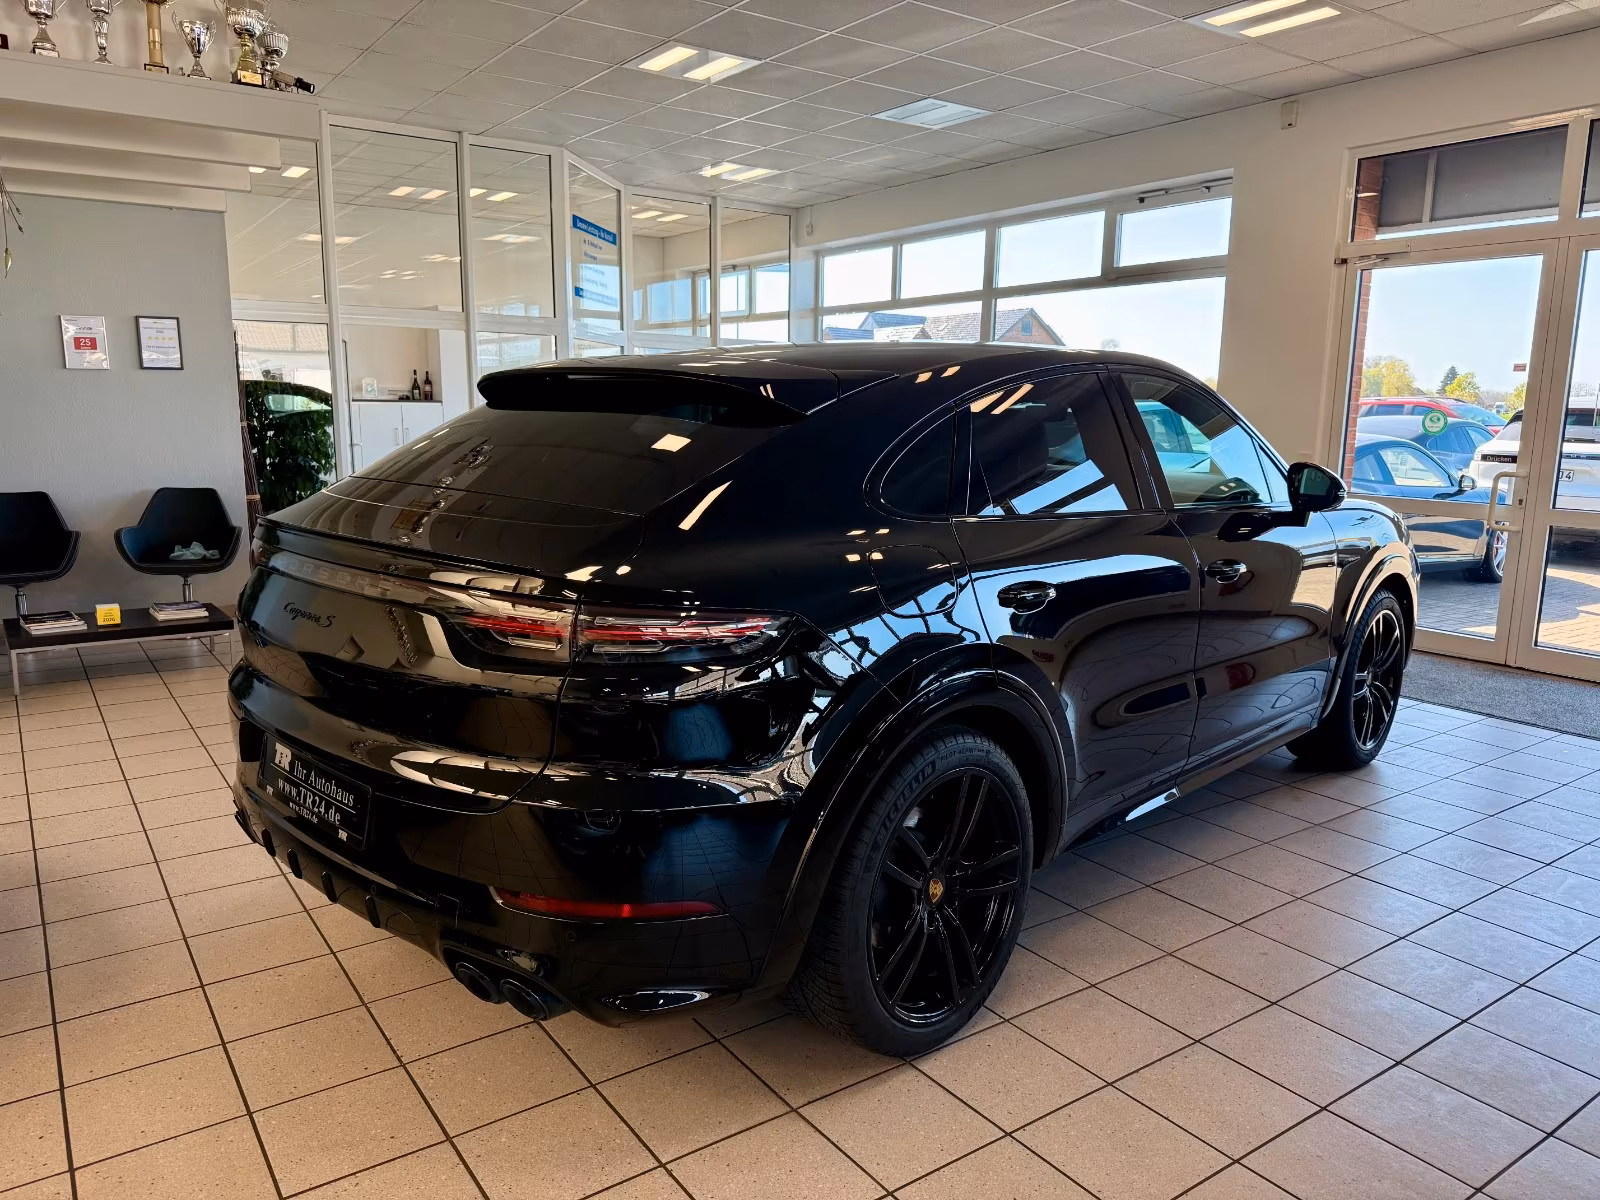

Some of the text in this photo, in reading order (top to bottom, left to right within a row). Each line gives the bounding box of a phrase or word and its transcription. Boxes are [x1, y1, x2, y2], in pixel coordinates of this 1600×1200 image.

[80, 338, 91, 346] 25
[1486, 455, 1512, 463] Drücken
[283, 602, 337, 628] Cayenne S
[940, 750, 956, 763] PILOT
[294, 760, 307, 780] Ihr
[308, 770, 354, 807] Autohaus
[278, 778, 341, 825] www.TR24.de
[289, 801, 318, 824] www.TR24.de
[877, 763, 933, 845] MICHELIN
